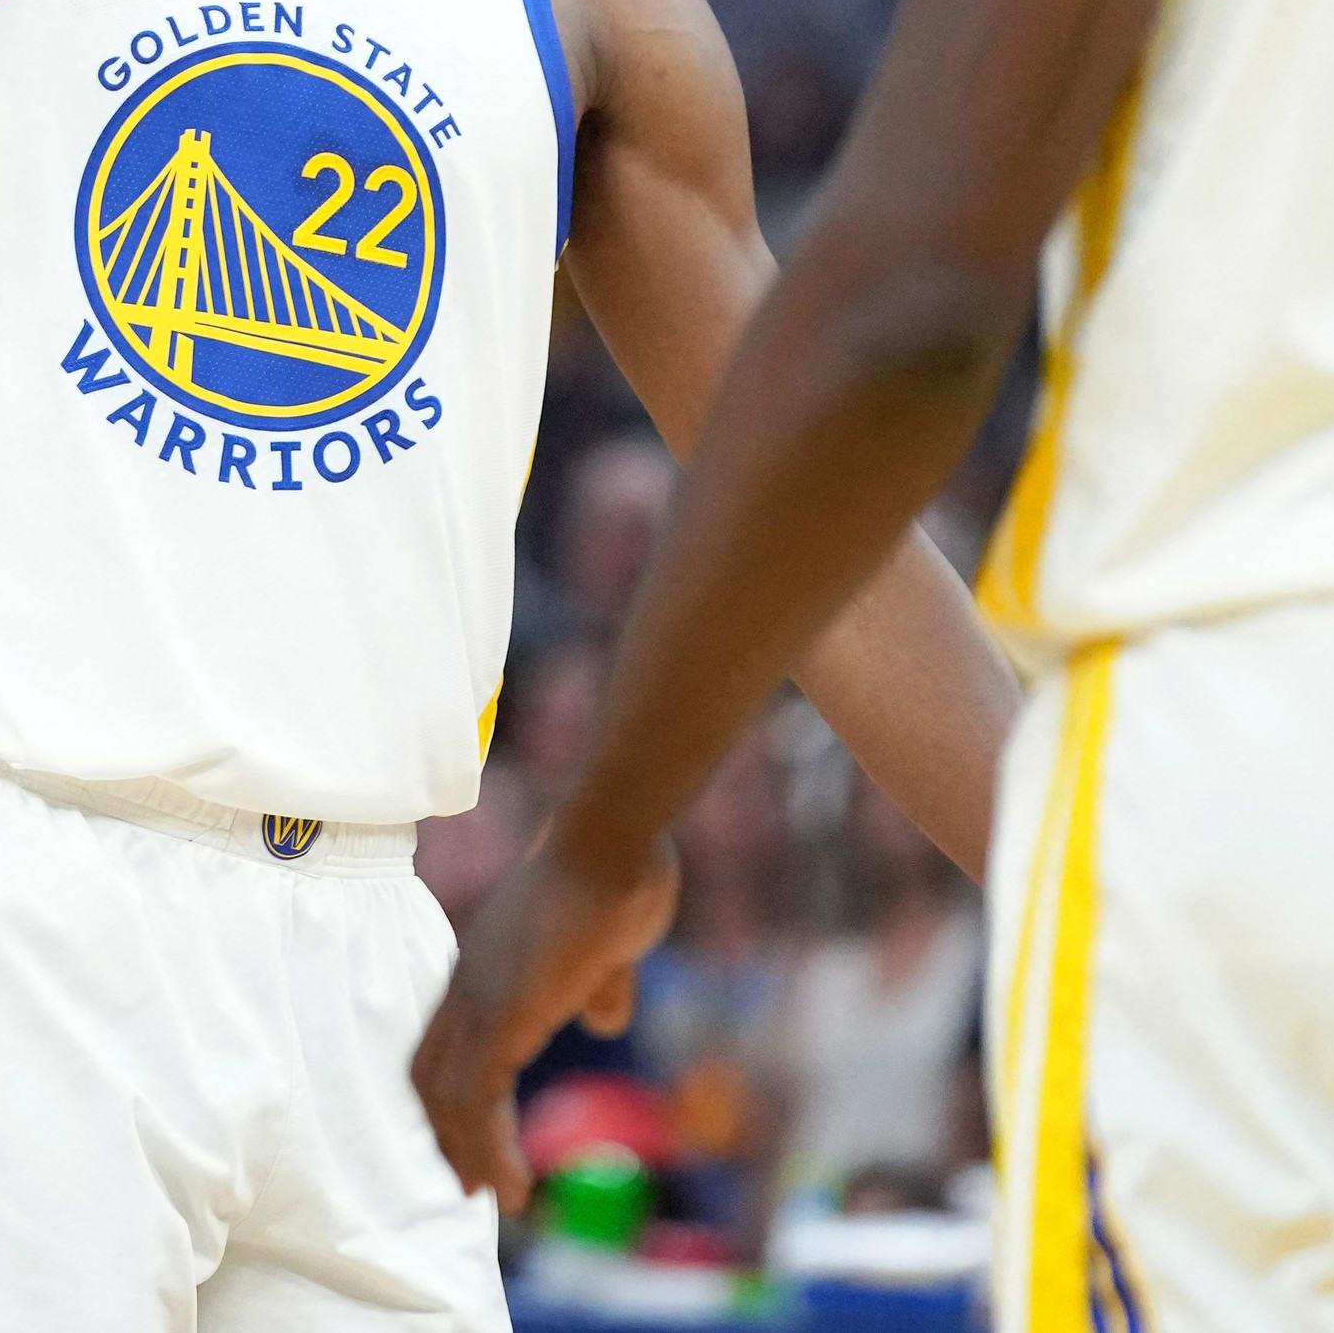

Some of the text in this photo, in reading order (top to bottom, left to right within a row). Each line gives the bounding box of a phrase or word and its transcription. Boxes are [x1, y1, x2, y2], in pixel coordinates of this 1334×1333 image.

[97, 1, 462, 150] GOLDEN STATE
[292, 152, 418, 269] 22
[59, 319, 444, 492] WARRIORS
